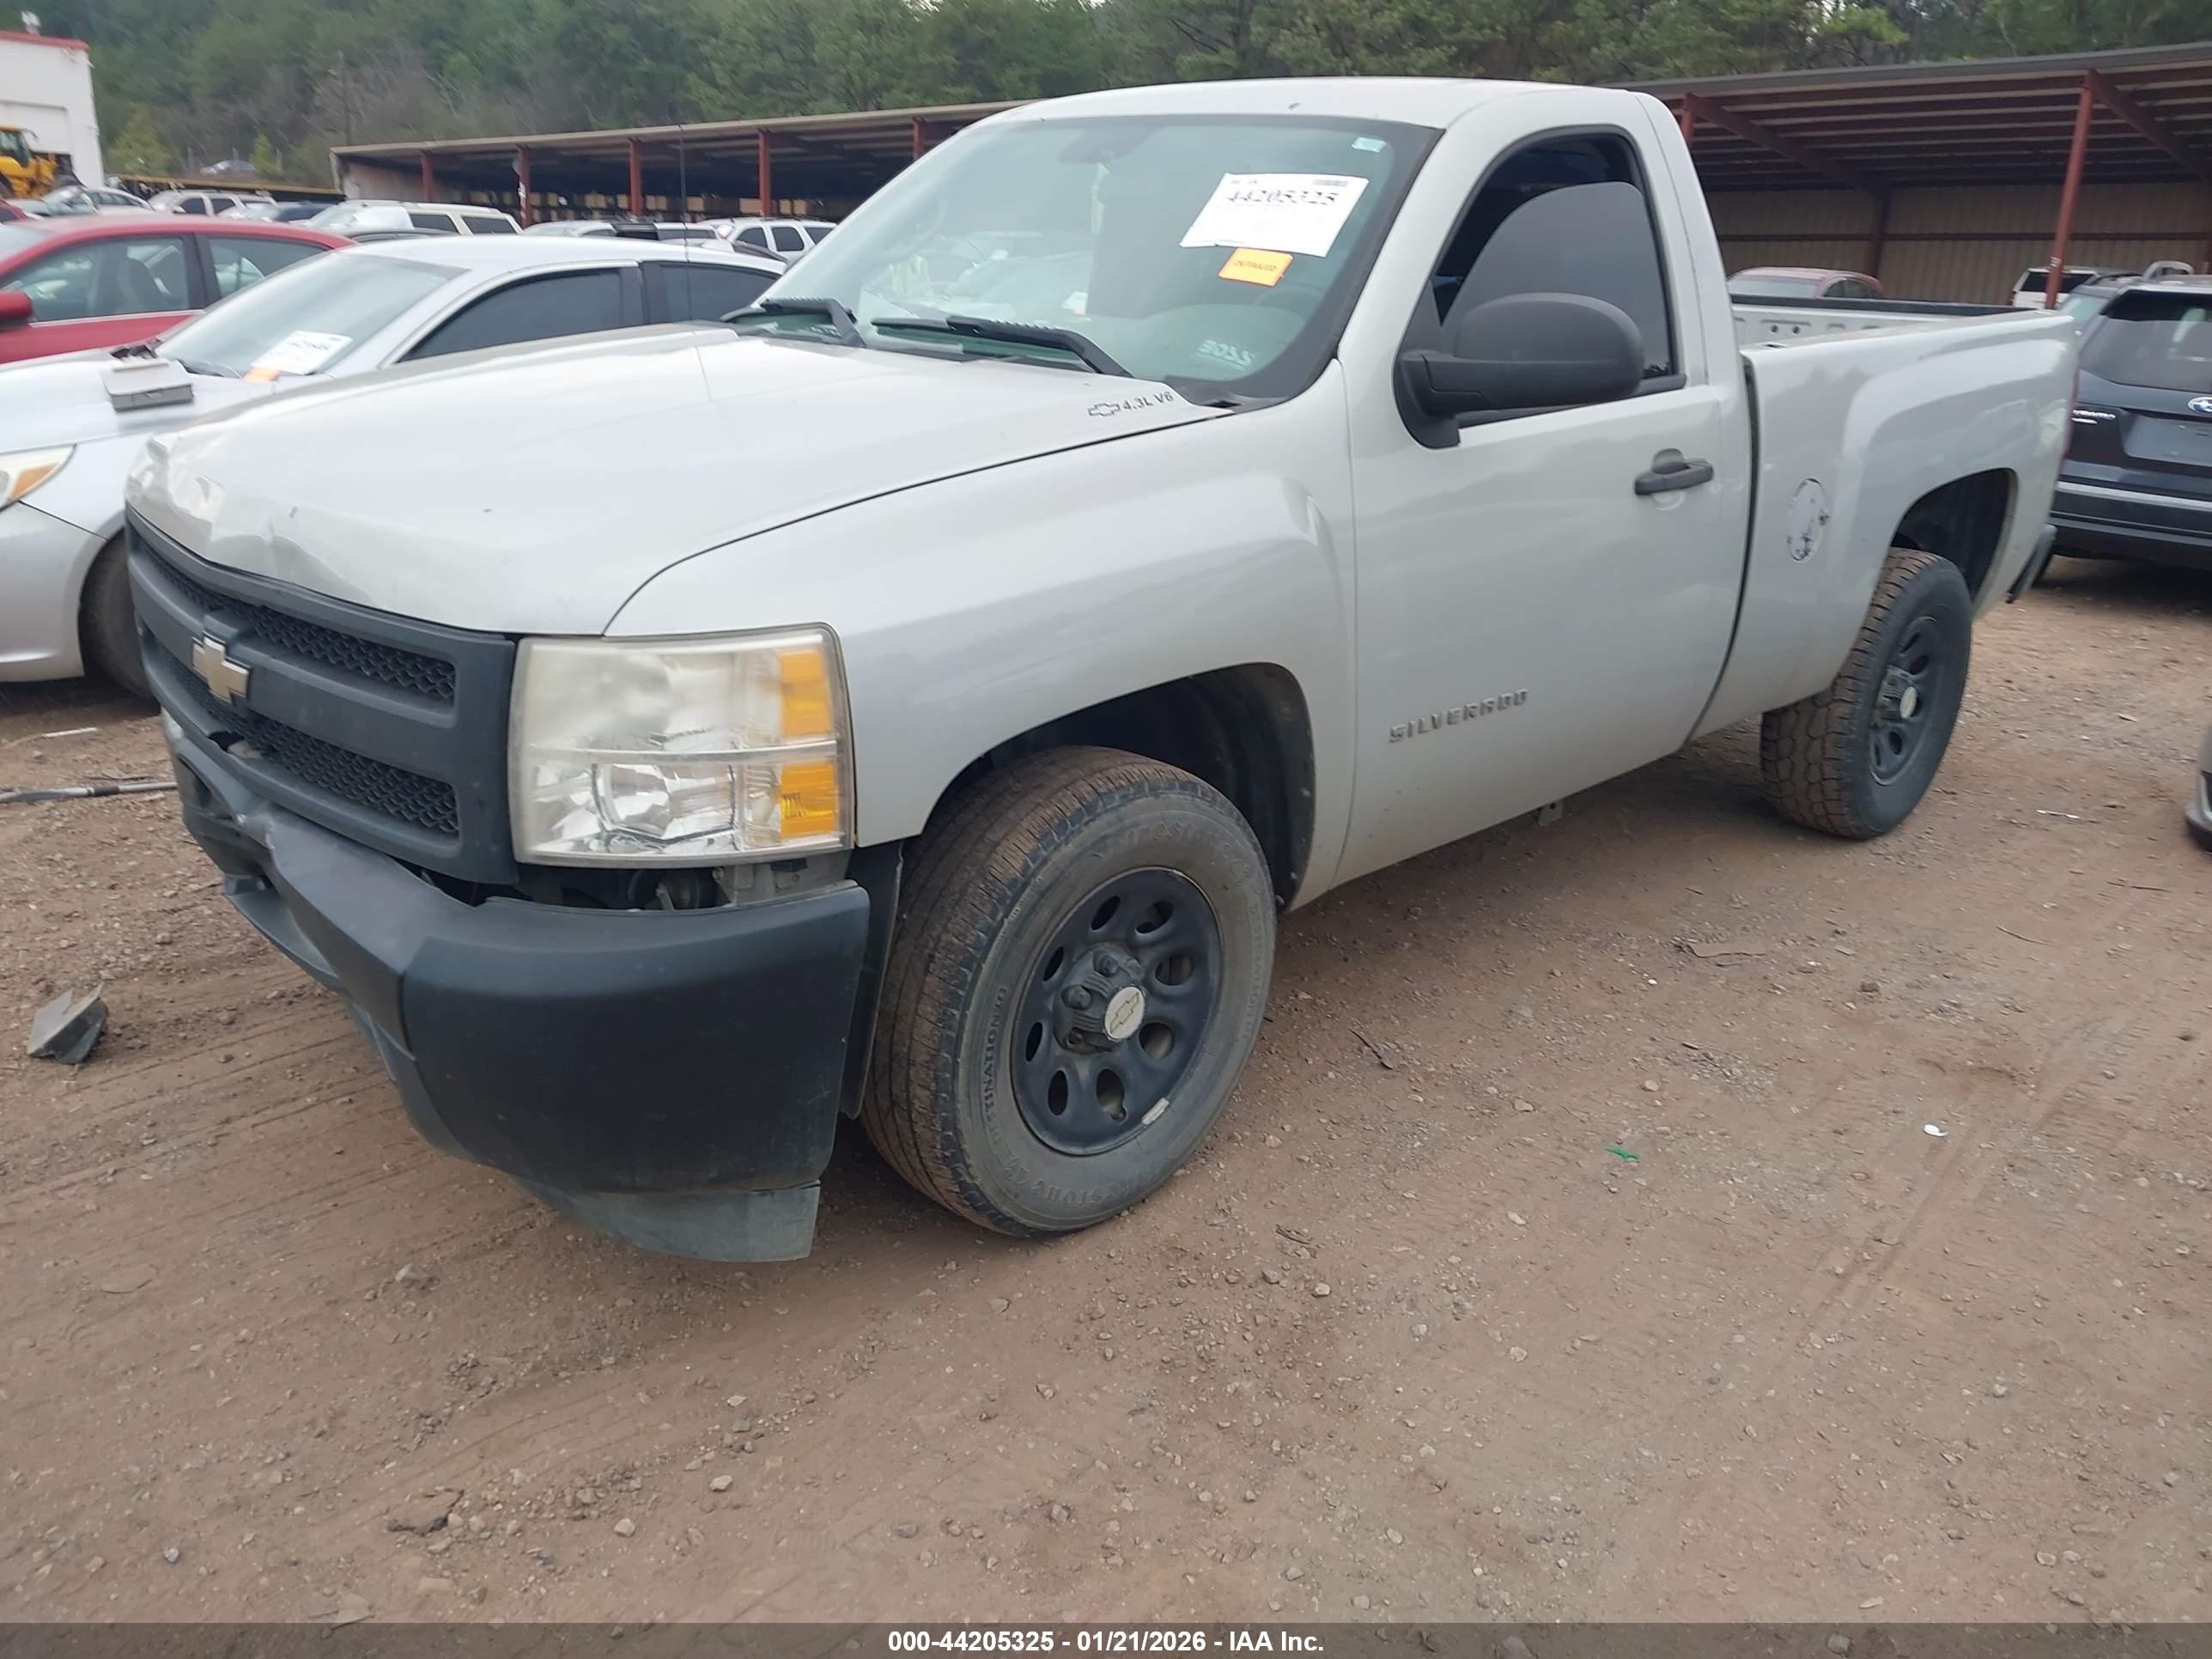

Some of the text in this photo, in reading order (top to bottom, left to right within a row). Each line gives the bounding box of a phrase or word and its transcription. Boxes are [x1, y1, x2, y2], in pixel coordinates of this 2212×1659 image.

[1121, 391, 1175, 411] 4.3L V6
[1389, 688, 1528, 744] SILVERADO
